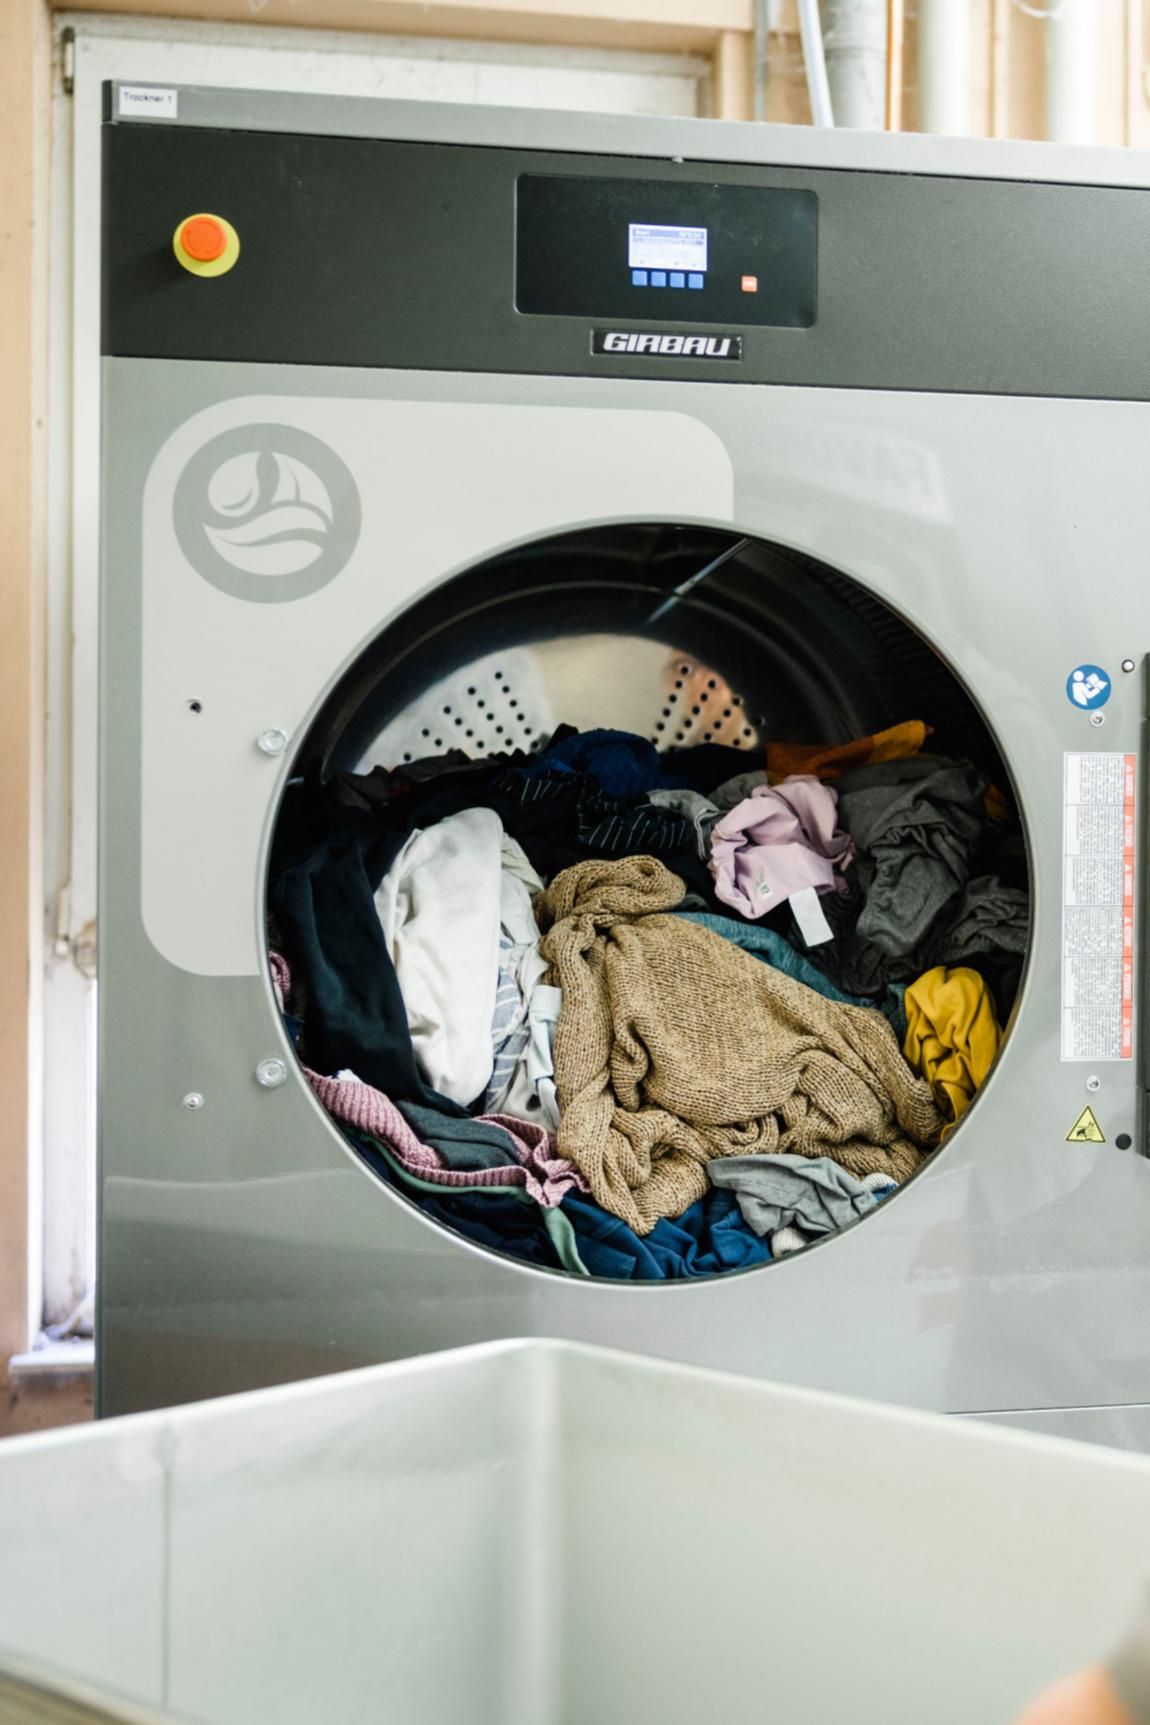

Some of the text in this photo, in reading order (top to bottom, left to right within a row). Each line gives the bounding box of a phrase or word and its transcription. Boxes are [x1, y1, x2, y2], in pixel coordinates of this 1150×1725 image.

[123, 91, 172, 103] Trockner 1
[603, 332, 731, 357] GIRBAU
